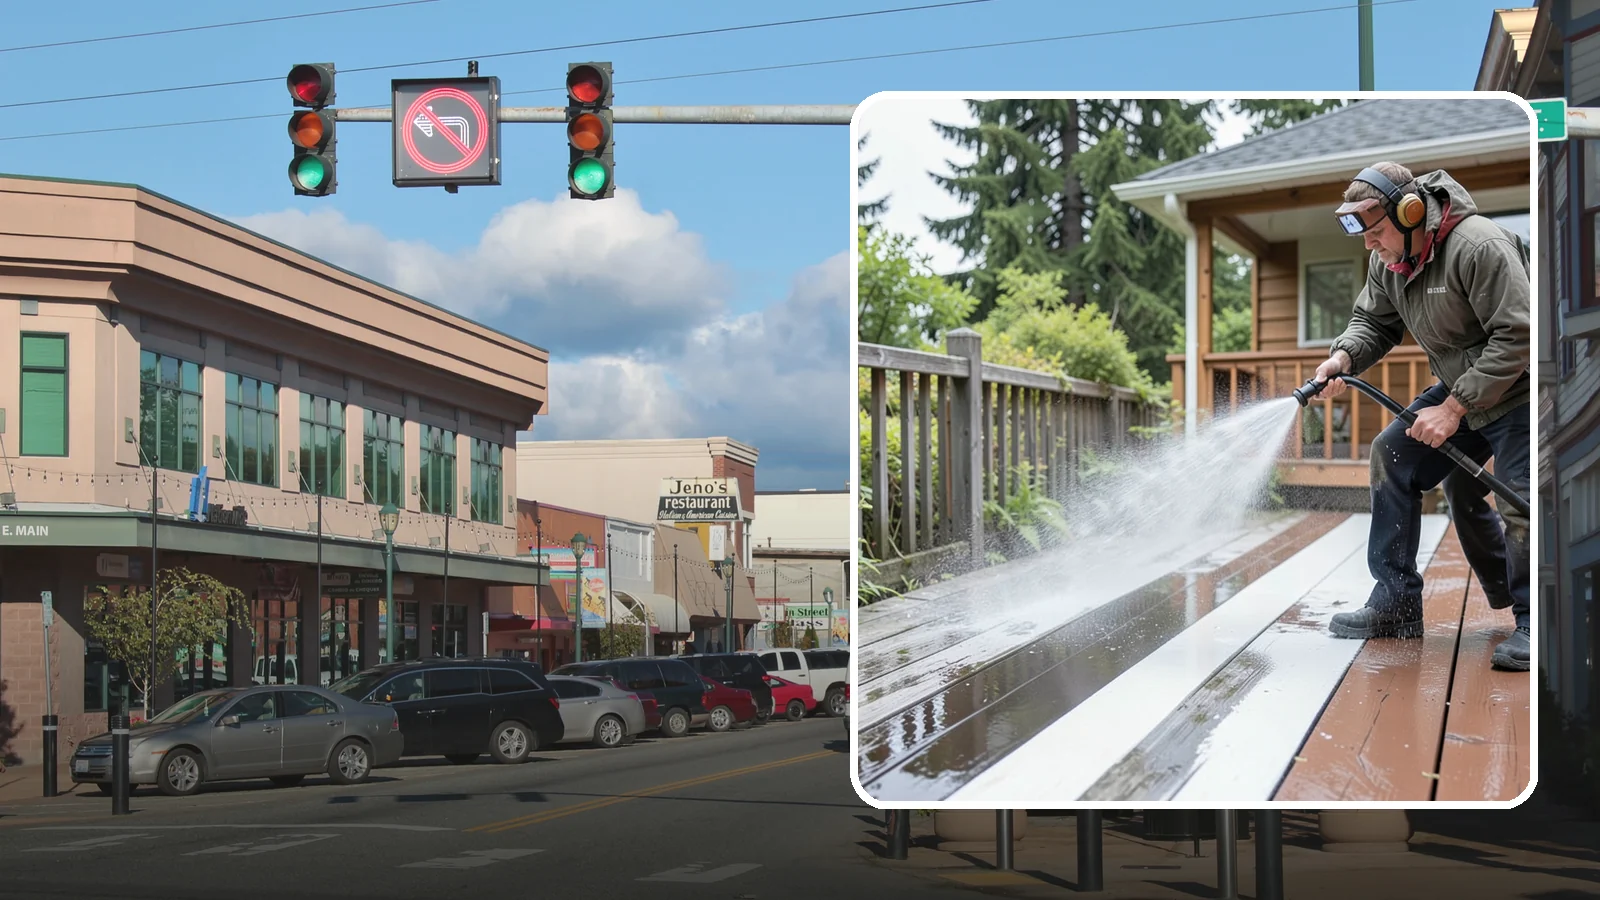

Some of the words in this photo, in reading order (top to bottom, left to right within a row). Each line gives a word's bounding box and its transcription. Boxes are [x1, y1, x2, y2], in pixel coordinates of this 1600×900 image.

[670, 480, 727, 495] Jeno's
[665, 496, 731, 509] restaurant
[659, 510, 681, 519] Italian
[686, 509, 714, 519] American
[715, 509, 737, 519] Cuisine
[2, 525, 13, 536] E.
[15, 525, 49, 536] MAIN
[797, 607, 828, 617] Street
